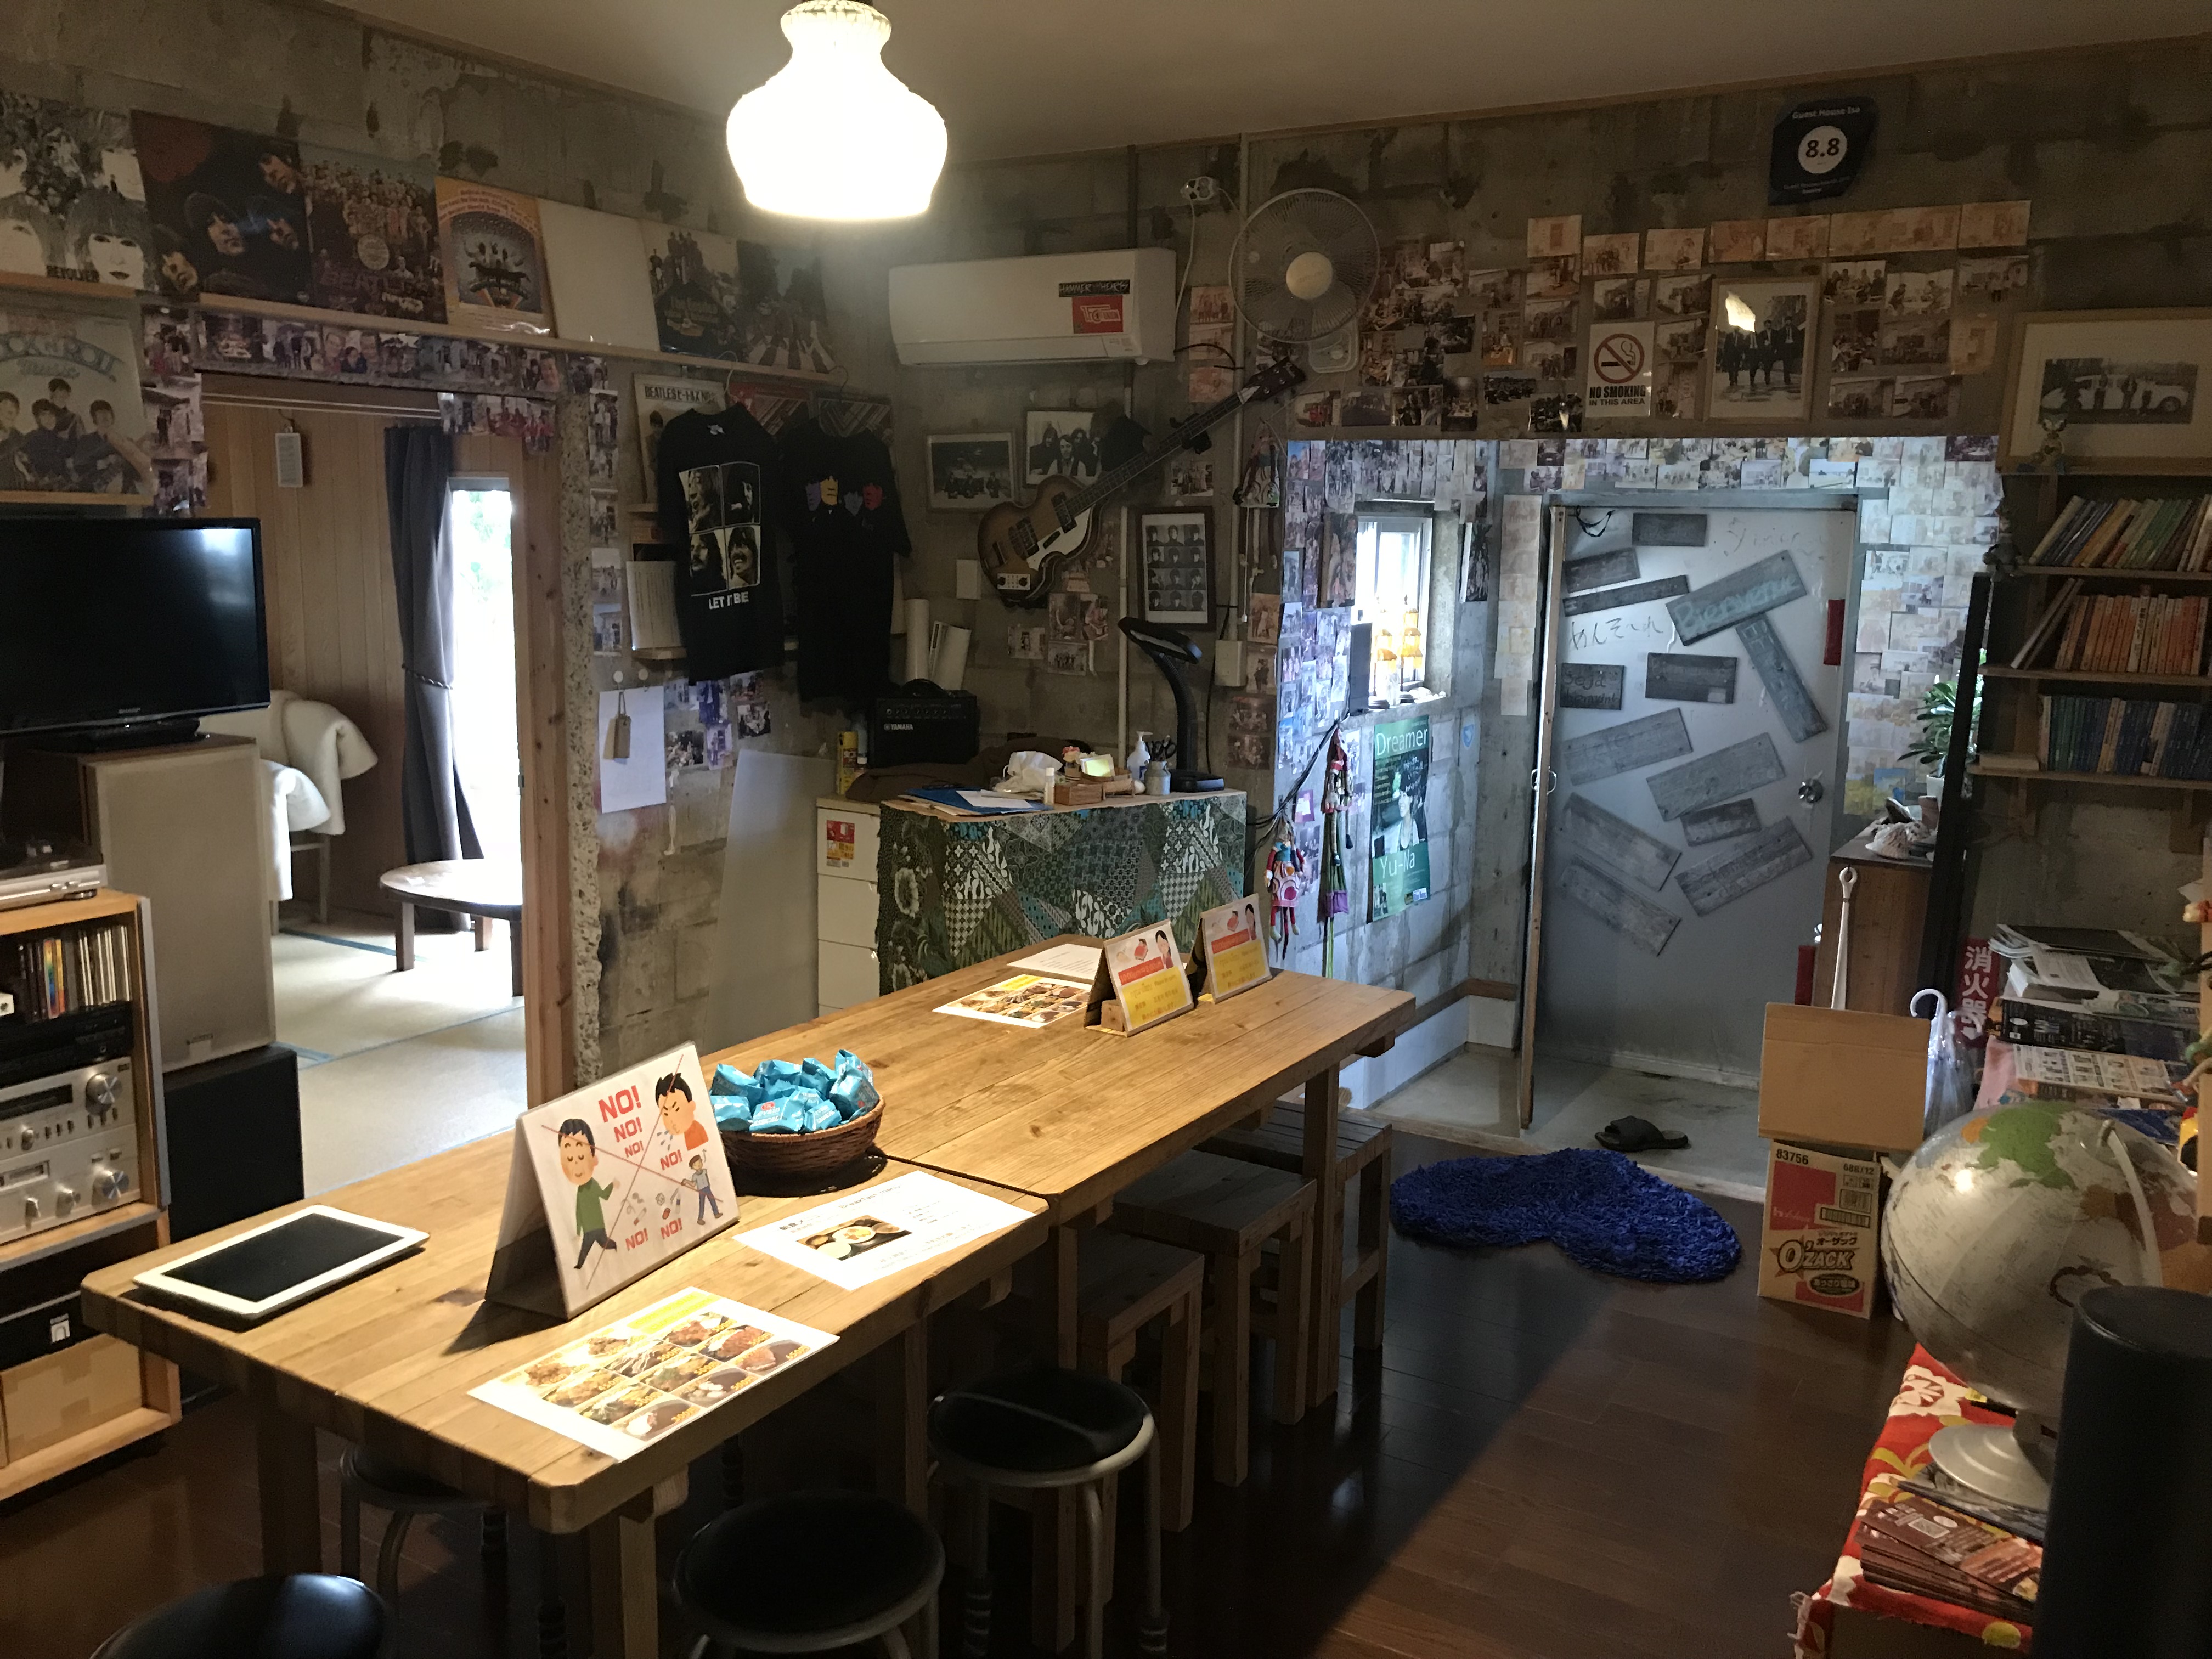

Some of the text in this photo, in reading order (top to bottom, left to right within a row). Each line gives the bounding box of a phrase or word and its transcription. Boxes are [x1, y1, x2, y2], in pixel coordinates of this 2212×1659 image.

[1805, 138, 1839, 158] 8.8
[1589, 385, 1645, 398] NO SMOKING
[709, 596, 724, 610] LET
[733, 591, 749, 604] BE
[1376, 723, 1428, 756] Dreamer
[1380, 849, 1415, 879] Yu-Na
[1962, 945, 1993, 1028] 消火器
[599, 1085, 641, 1122] NO!
[613, 1117, 642, 1142] NO!
[624, 1141, 644, 1158] NO!
[660, 1149, 682, 1170] NO!
[1776, 1149, 1809, 1165] 83756
[839, 1193, 877, 1209] Breakfast
[661, 1218, 682, 1239] NO!
[625, 1228, 648, 1251] NO!
